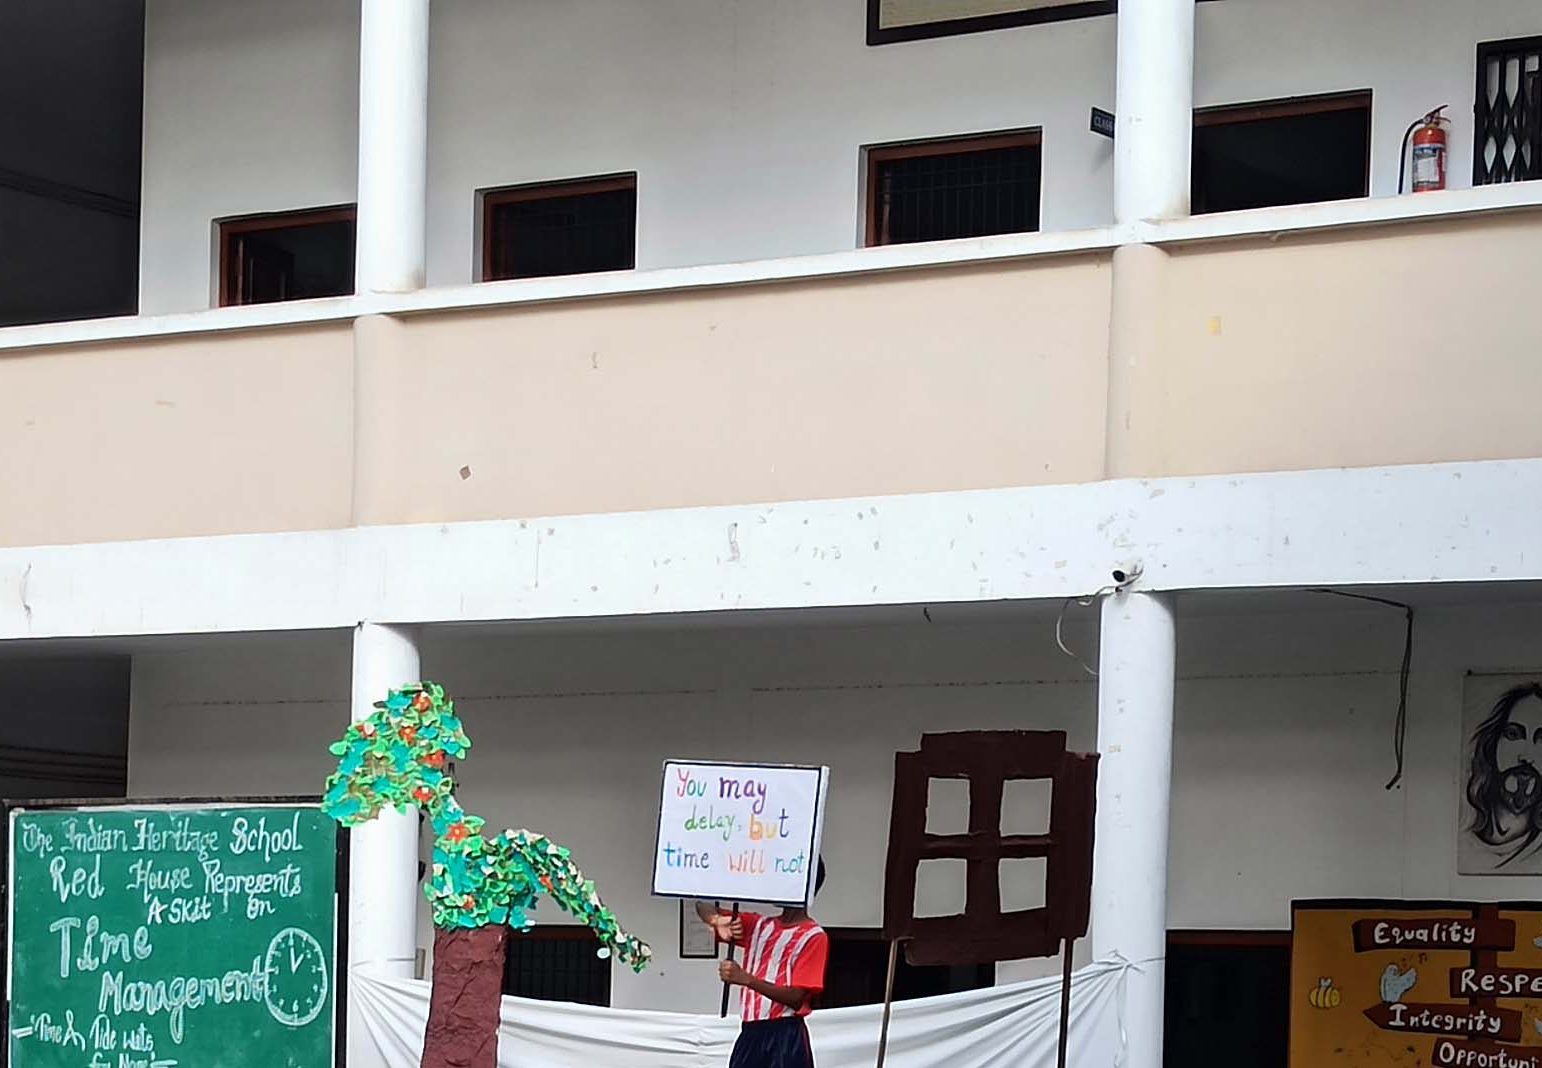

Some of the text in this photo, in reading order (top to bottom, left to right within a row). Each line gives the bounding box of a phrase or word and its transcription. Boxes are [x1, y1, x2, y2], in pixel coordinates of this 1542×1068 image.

[676, 768, 767, 815] You may
[23, 812, 303, 862] The Indian Heritage School
[749, 808, 789, 840] but
[663, 841, 804, 874] time will not
[50, 854, 301, 913] Red House Represents
[148, 896, 168, 925] A
[50, 916, 152, 978] Time
[1373, 921, 1476, 945] Equality
[99, 956, 266, 1044] Management
[1388, 1003, 1501, 1033] Integrity
[90, 1014, 116, 1050] Tide
